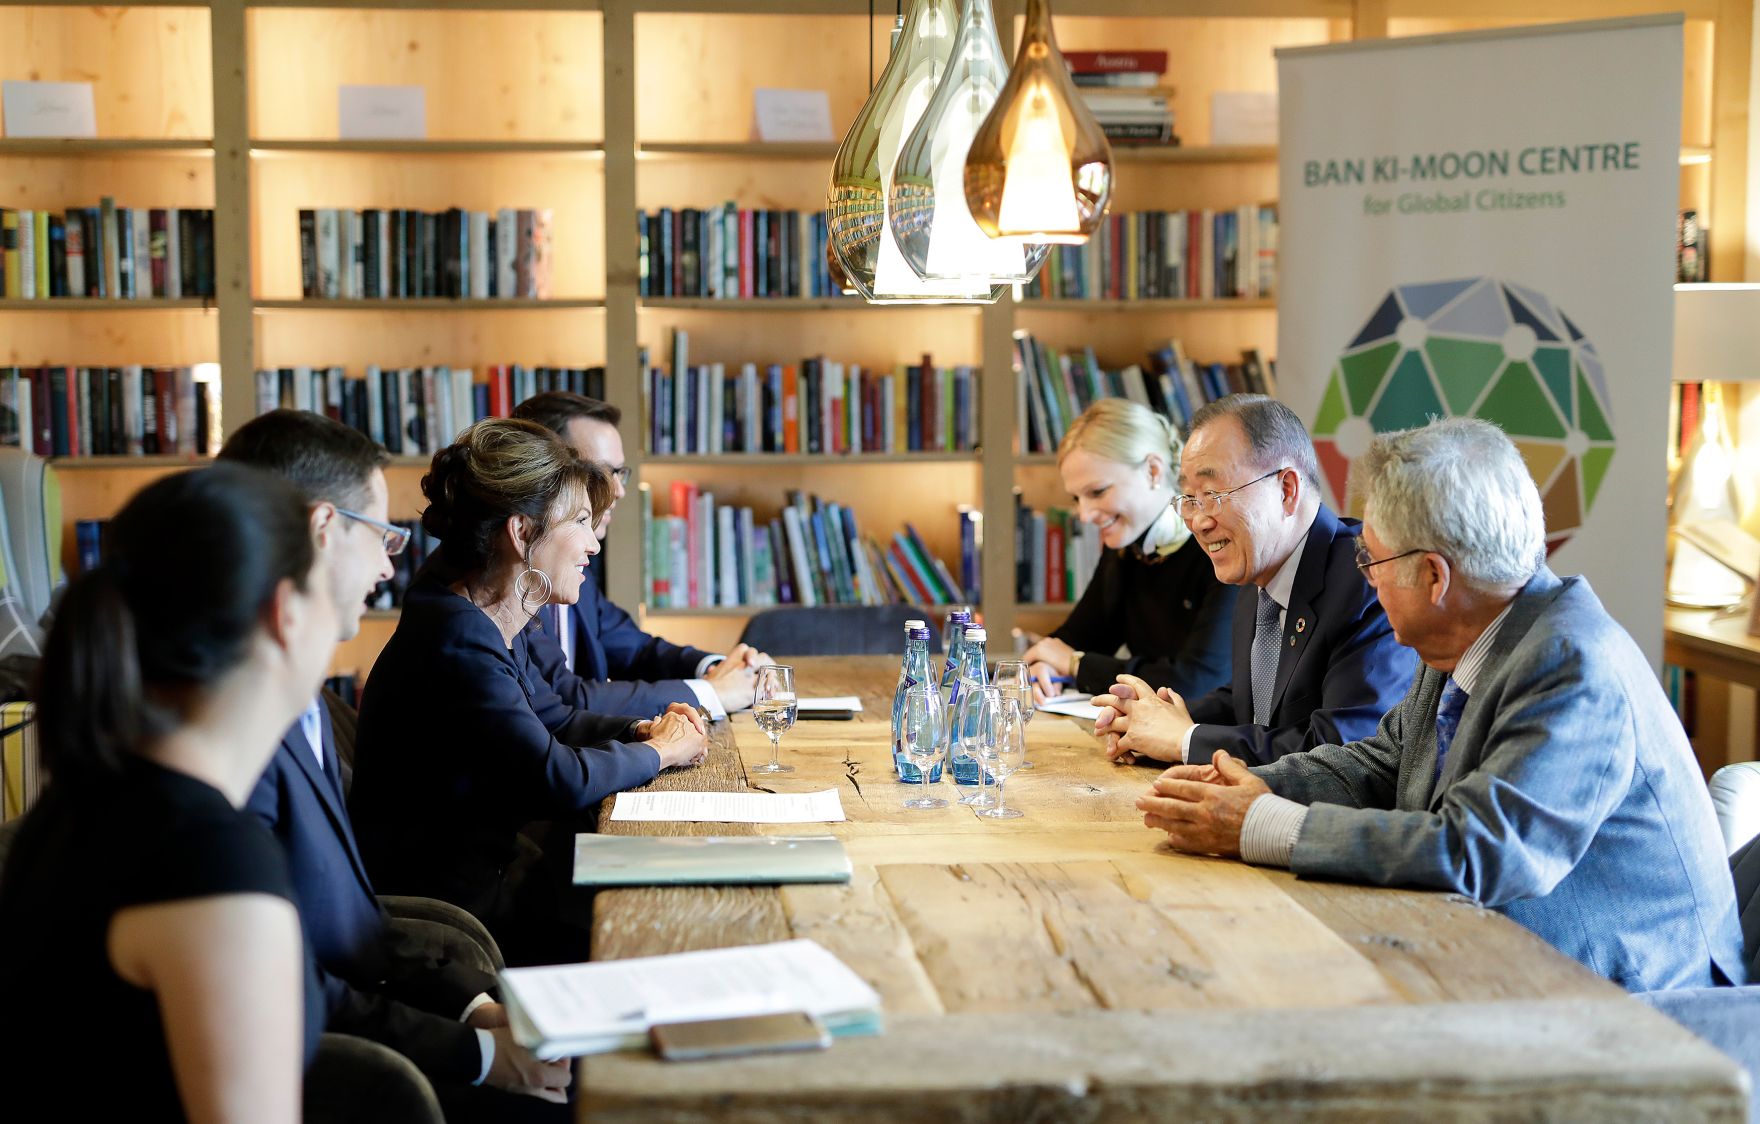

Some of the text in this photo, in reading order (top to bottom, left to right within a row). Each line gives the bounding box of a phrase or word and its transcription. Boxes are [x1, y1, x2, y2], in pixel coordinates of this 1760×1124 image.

[1304, 141, 1641, 187] BAN KI-MOON CENTRE
[1363, 190, 1566, 215] for Global Citizens
